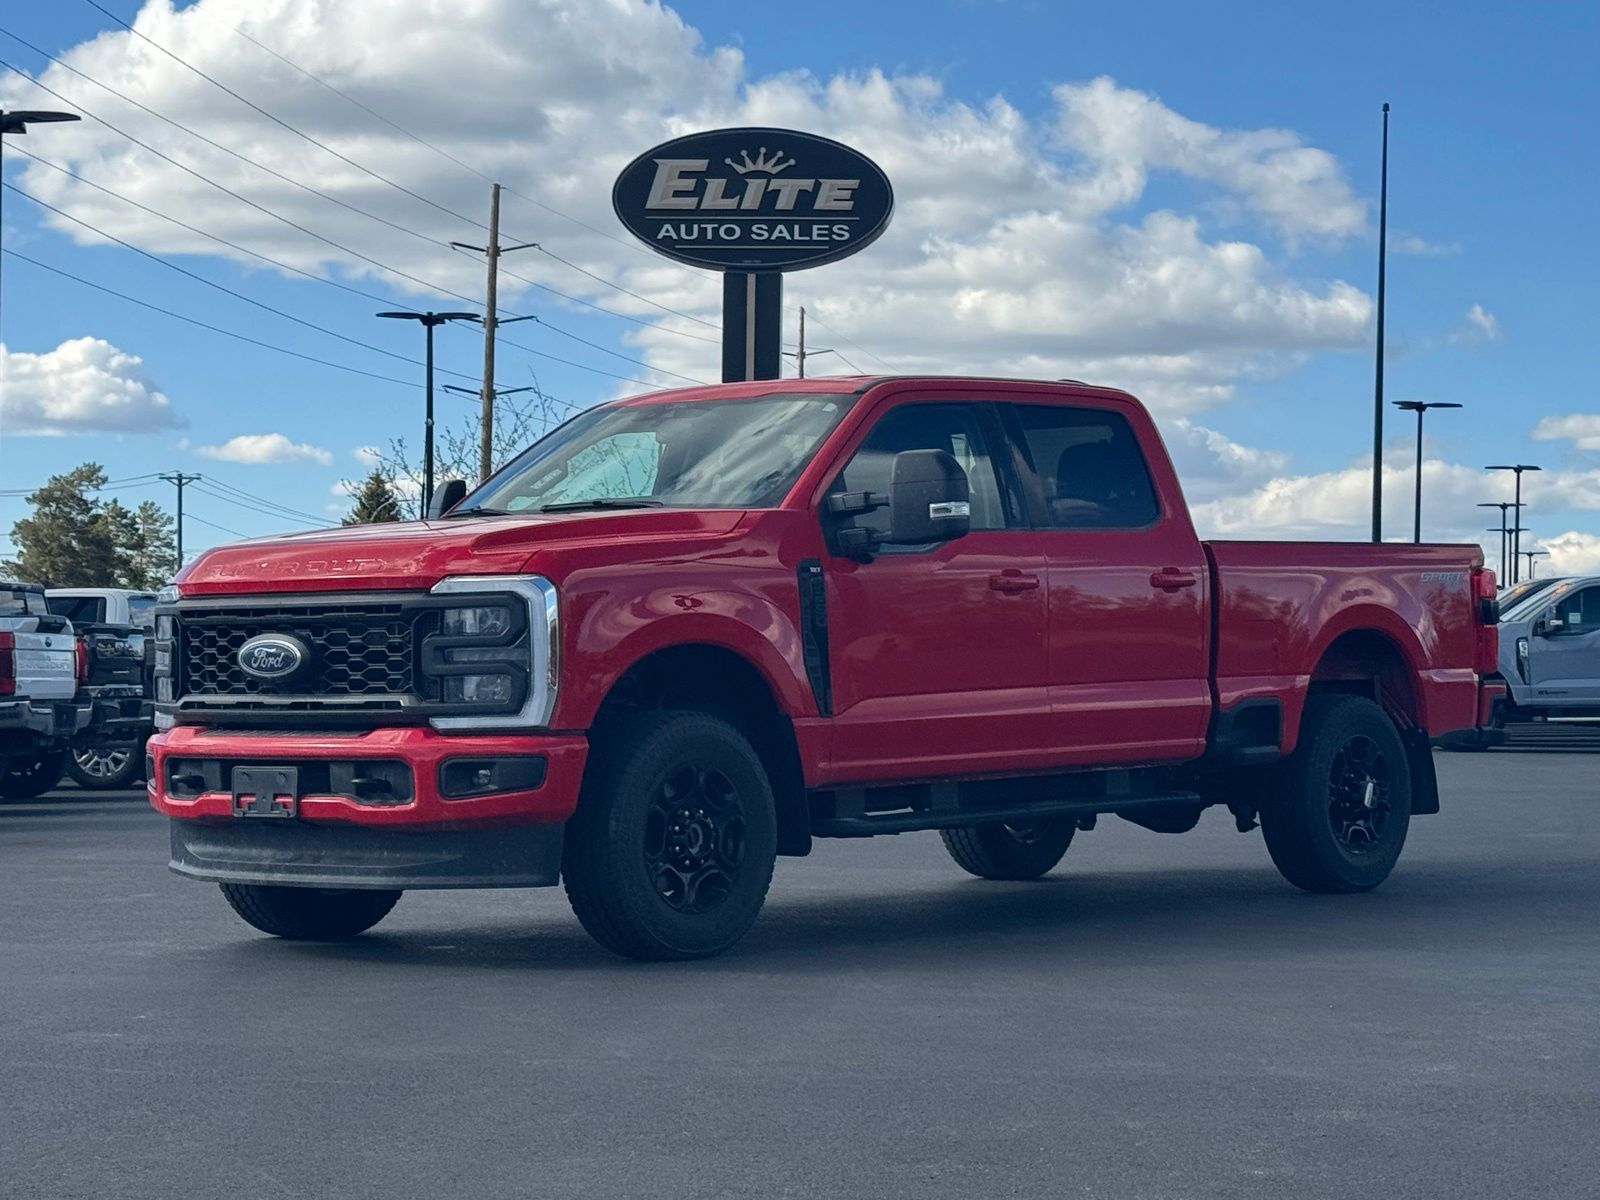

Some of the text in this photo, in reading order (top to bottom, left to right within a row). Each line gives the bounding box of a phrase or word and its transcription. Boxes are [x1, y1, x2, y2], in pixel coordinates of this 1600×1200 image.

[656, 223, 850, 242] AUTO SALES
[251, 647, 285, 669] Ford
